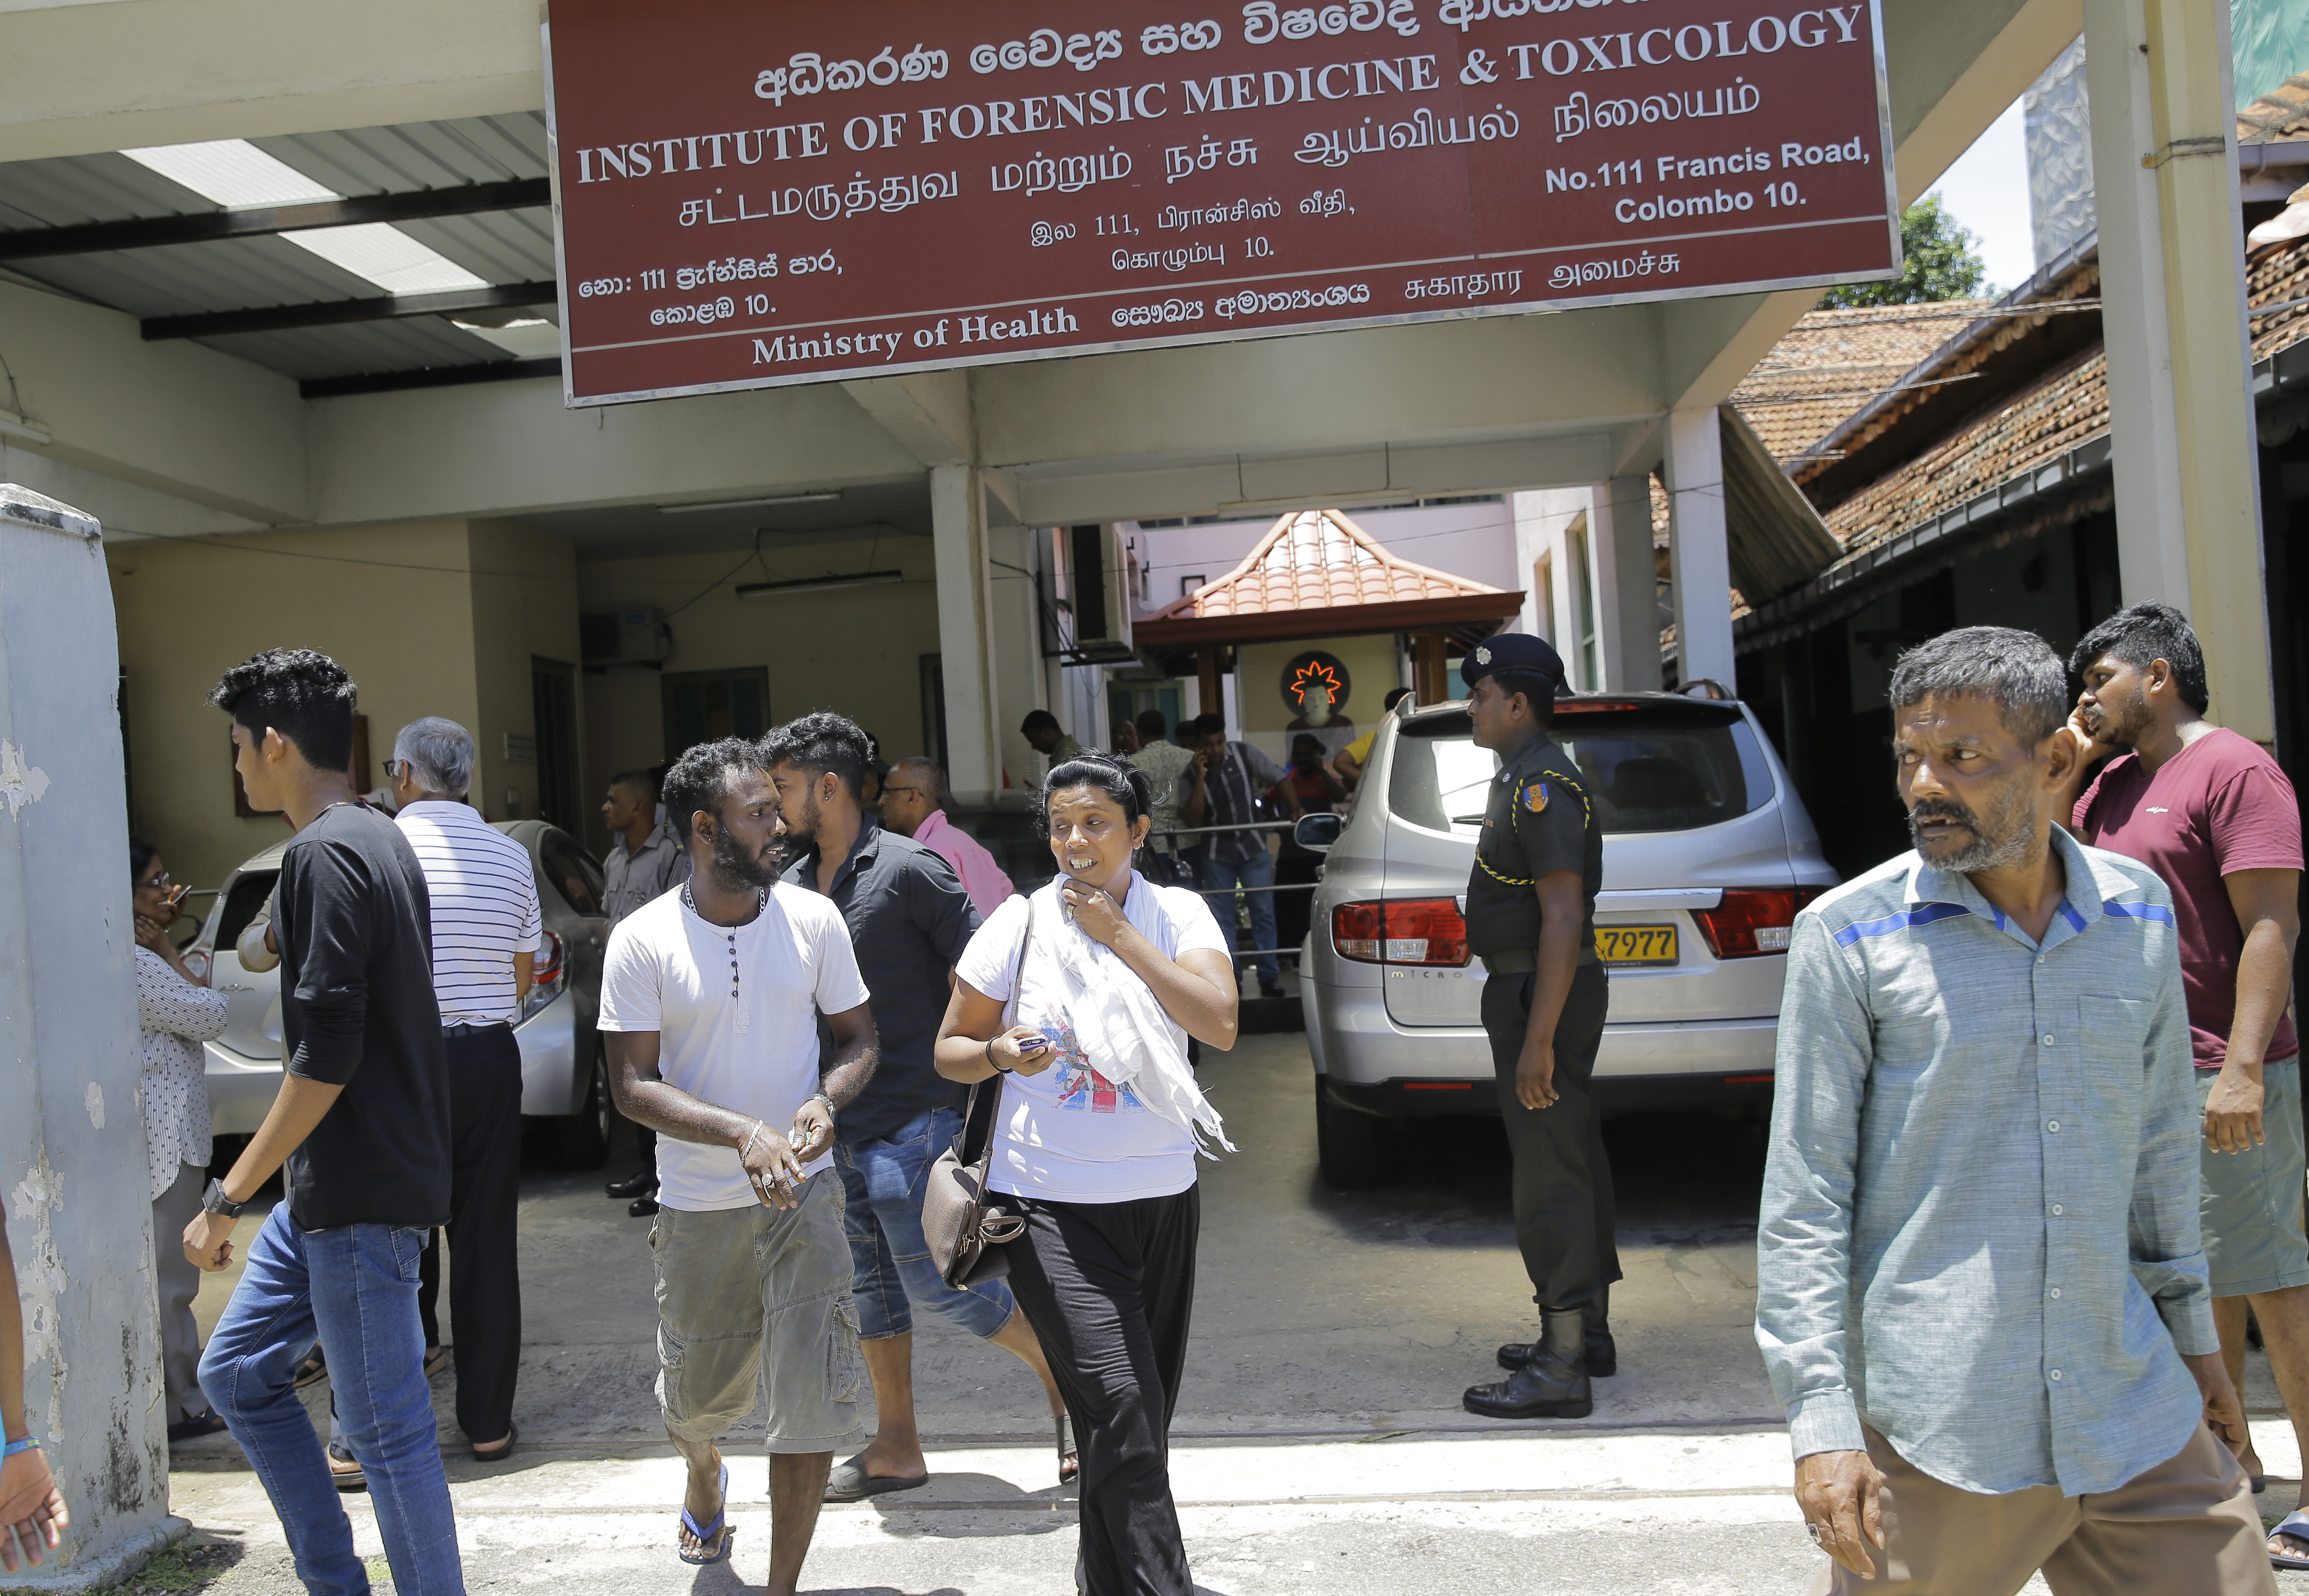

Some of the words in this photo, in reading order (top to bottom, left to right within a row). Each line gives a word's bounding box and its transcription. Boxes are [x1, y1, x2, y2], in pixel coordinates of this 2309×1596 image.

[754, 43, 949, 107] අධිකරණ
[969, 28, 1123, 75] වෛද්‍ය
[1139, 19, 1222, 56] සහ
[576, 121, 828, 184] INSTITUTE
[843, 112, 907, 152] OF
[917, 81, 1167, 144] FORENSIC
[1180, 53, 1440, 115] MEDICINE
[1459, 48, 1499, 86] &
[1507, 4, 1863, 81] TOXICOLOGY
[678, 170, 958, 227] சட்டமருத்துவ
[991, 144, 1132, 198] மற்றும்
[1164, 133, 1258, 185] நச்சு
[1293, 103, 1520, 168] ஆய்வியல்
[1554, 76, 1761, 144] நிலையம்
[1545, 158, 1643, 194] No.111
[1656, 146, 1772, 182] Francis
[1780, 135, 1870, 169] Road,
[1030, 220, 1077, 247] இல
[1095, 213, 1140, 236] 111,
[1157, 196, 1281, 233] பிரான்சிஸ்
[1299, 188, 1355, 218] வீதி,
[1614, 188, 1754, 224] Colombo
[1763, 180, 1807, 208] 10.
[639, 268, 666, 291] 111
[788, 248, 843, 276] පාර,
[1111, 241, 1225, 272] கொழும்பு
[1244, 236, 1275, 258] 10.
[1404, 269, 1523, 300] சுகாதார
[1547, 249, 1681, 289] அமைச்சு
[649, 295, 735, 326] කොළඹ
[744, 293, 777, 316] 10.
[1111, 298, 1204, 328] සෞඛ්‍ය
[1214, 283, 1371, 321] අමාත්‍යංශය
[751, 331, 903, 365] Ministry
[913, 318, 949, 348] of
[957, 306, 1080, 344] Health
[1604, 931, 1672, 957] 7977
